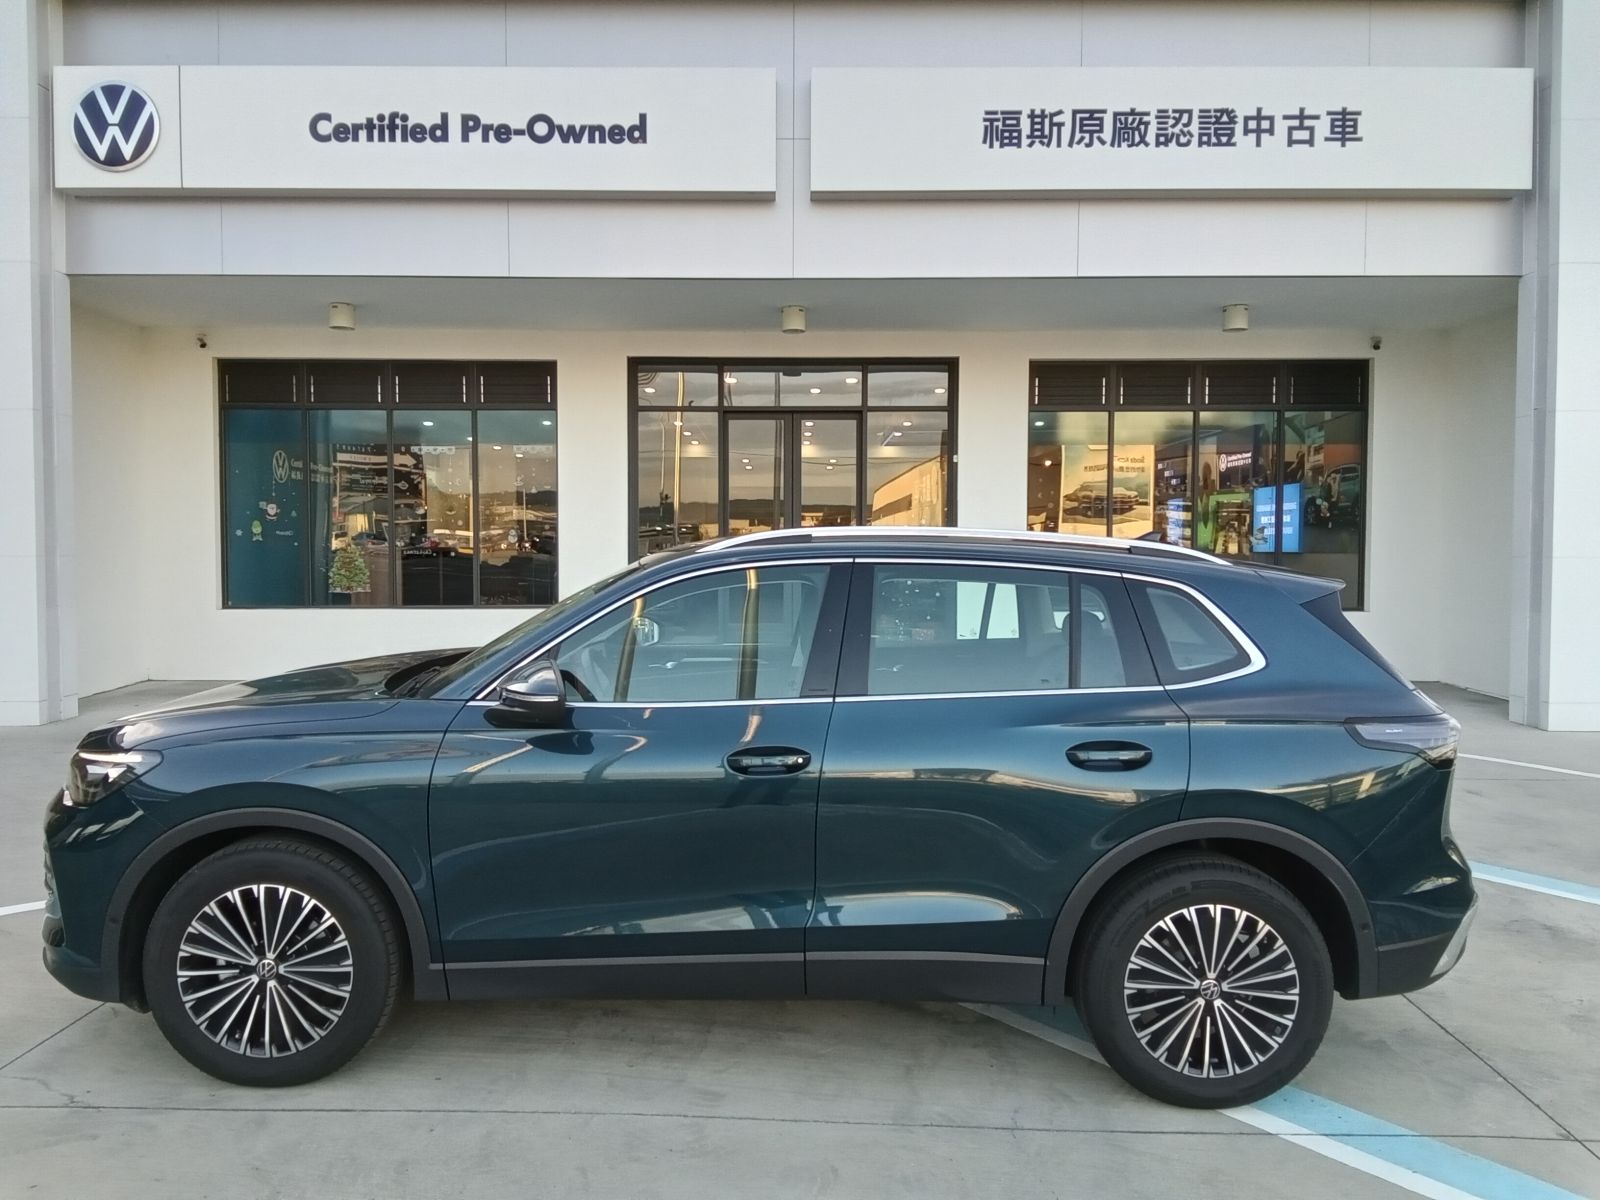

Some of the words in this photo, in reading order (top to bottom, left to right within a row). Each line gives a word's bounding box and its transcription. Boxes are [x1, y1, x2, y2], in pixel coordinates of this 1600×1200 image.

[309, 111, 449, 143] Certified
[461, 113, 647, 144] Pre-Owned
[982, 107, 1363, 149] 福斯原廠認證中古車
